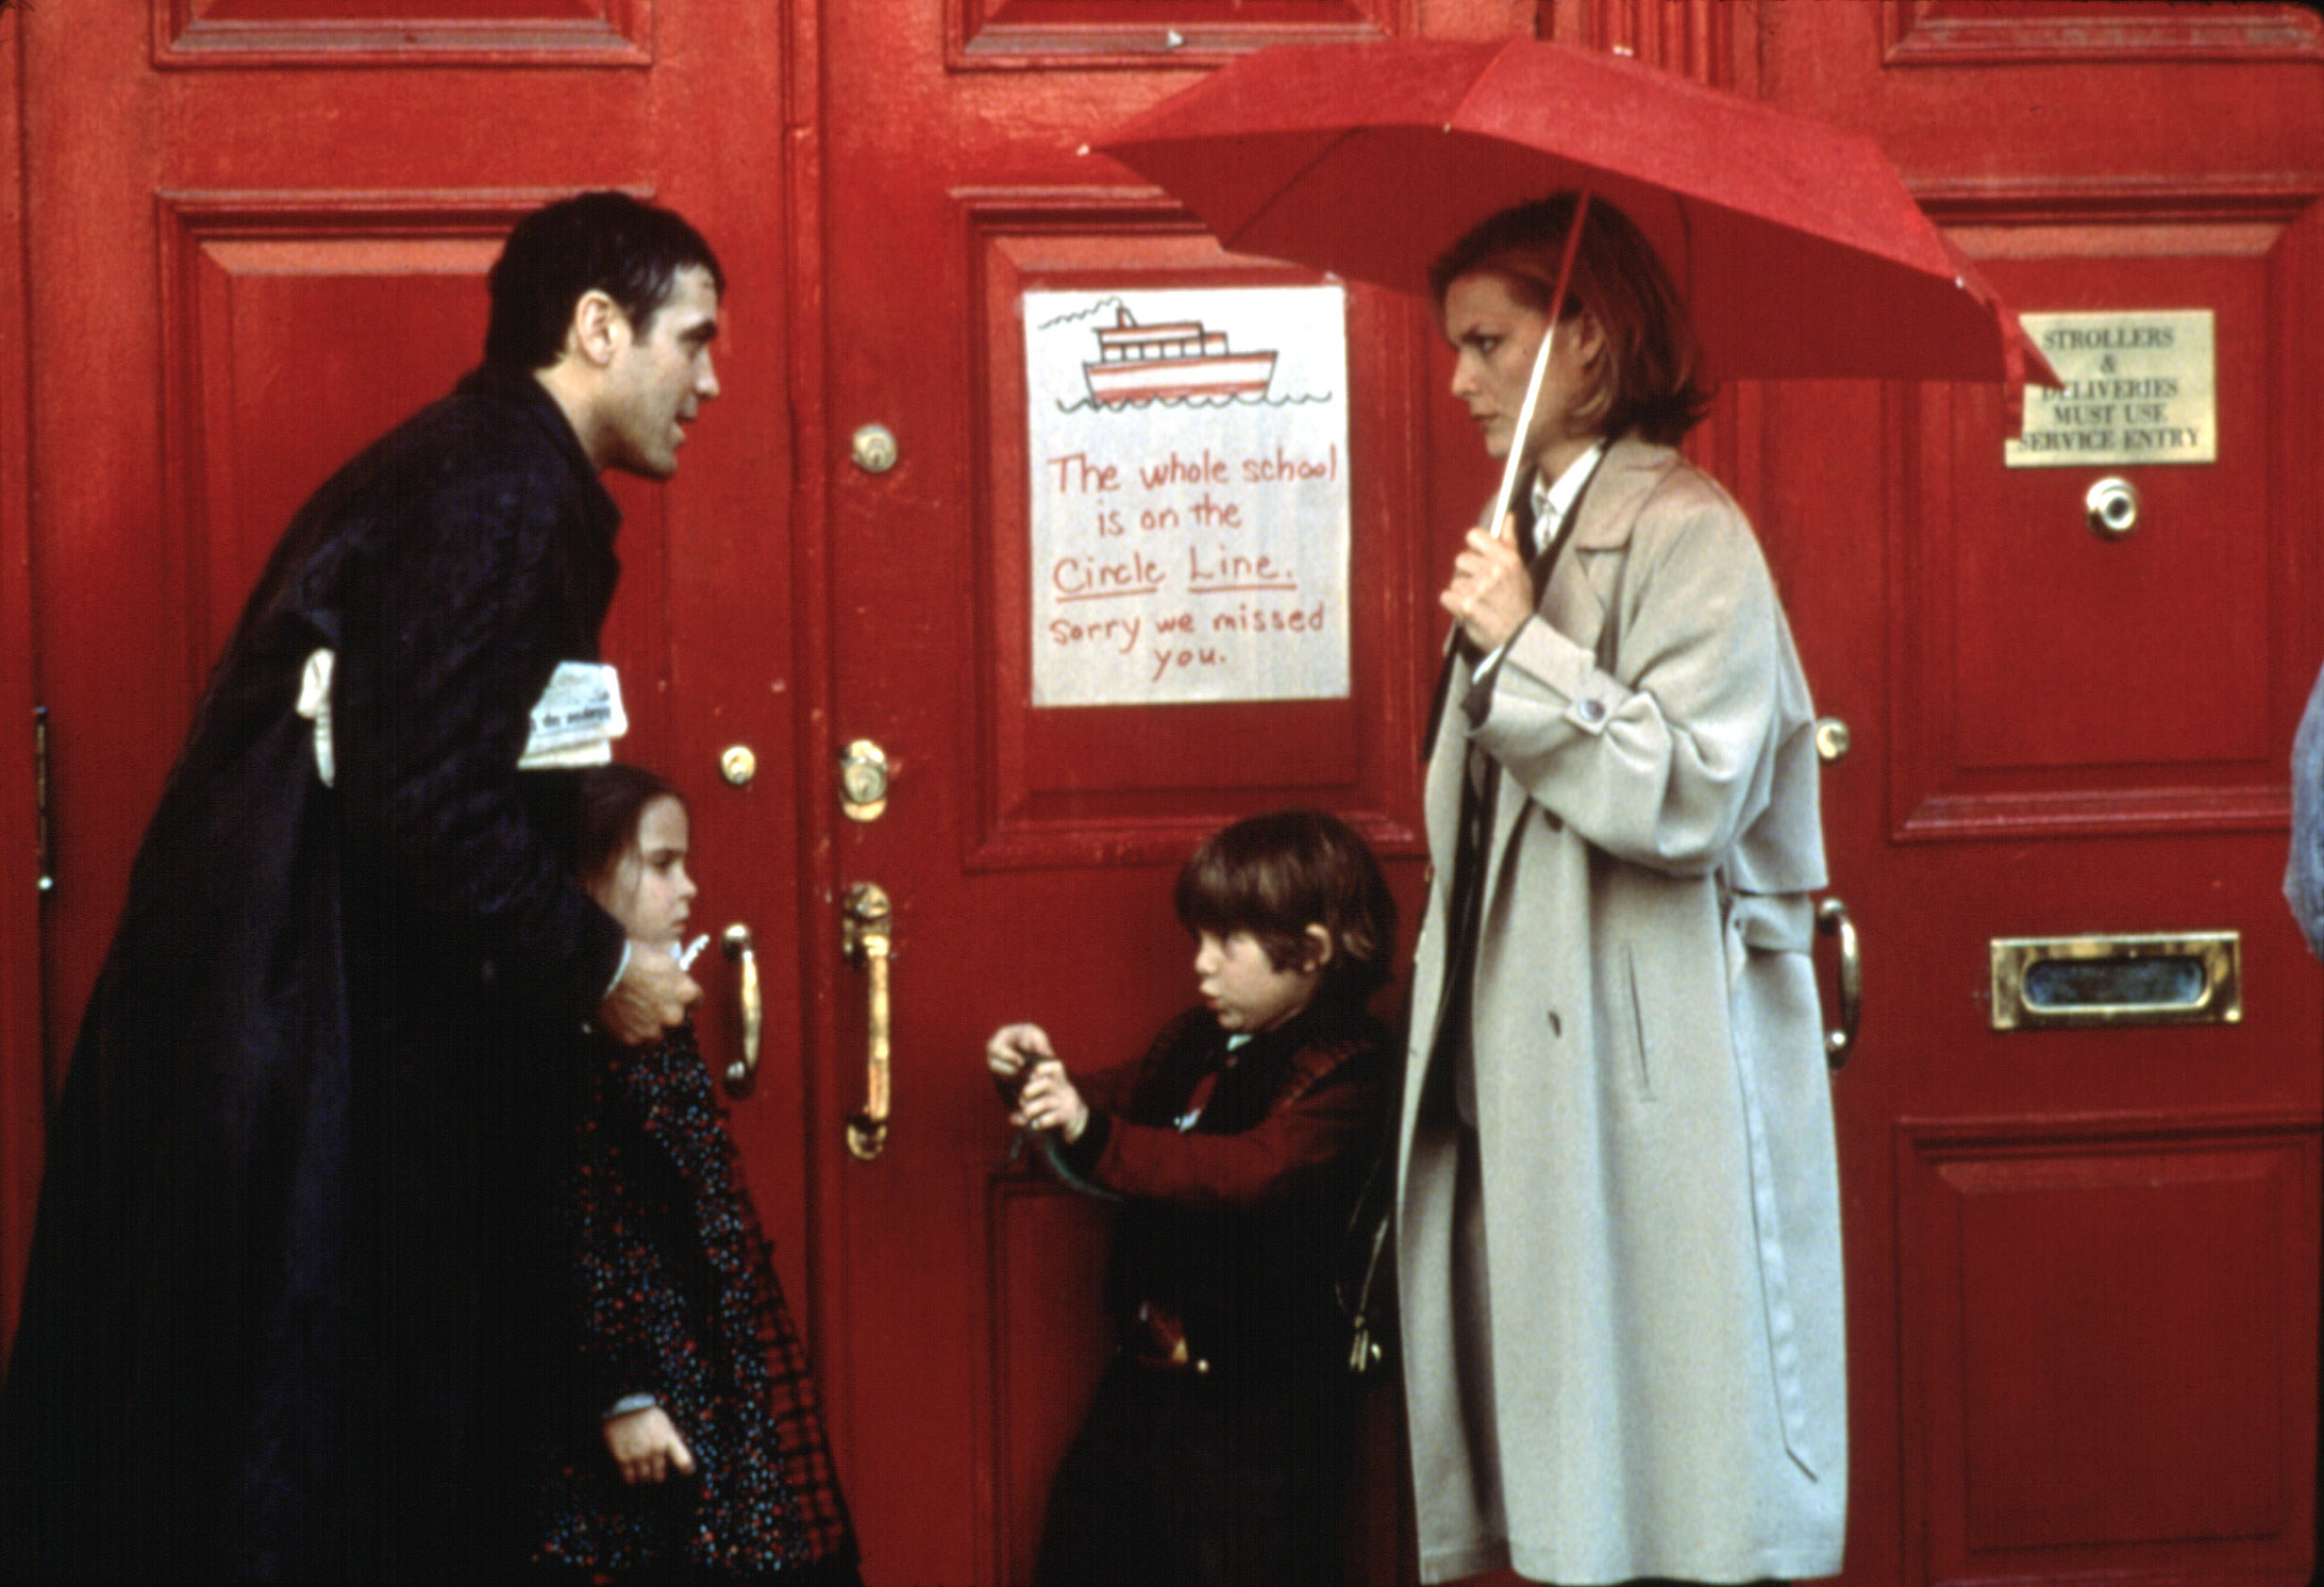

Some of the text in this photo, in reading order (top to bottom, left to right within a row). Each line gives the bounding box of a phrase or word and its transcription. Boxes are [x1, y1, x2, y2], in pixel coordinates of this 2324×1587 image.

[2043, 326, 2175, 350] STROLLERS
[2099, 353, 2116, 374] &
[2053, 403, 2166, 426] MUST USE
[2124, 427, 2199, 451] ENTRY
[1047, 443, 1337, 493] The whole school
[1097, 493, 1244, 537] is on the
[1052, 545, 1293, 594] Circle Line.
[1155, 611, 1195, 635] we
[1212, 602, 1326, 633] missed
[1153, 645, 1228, 684] you.
